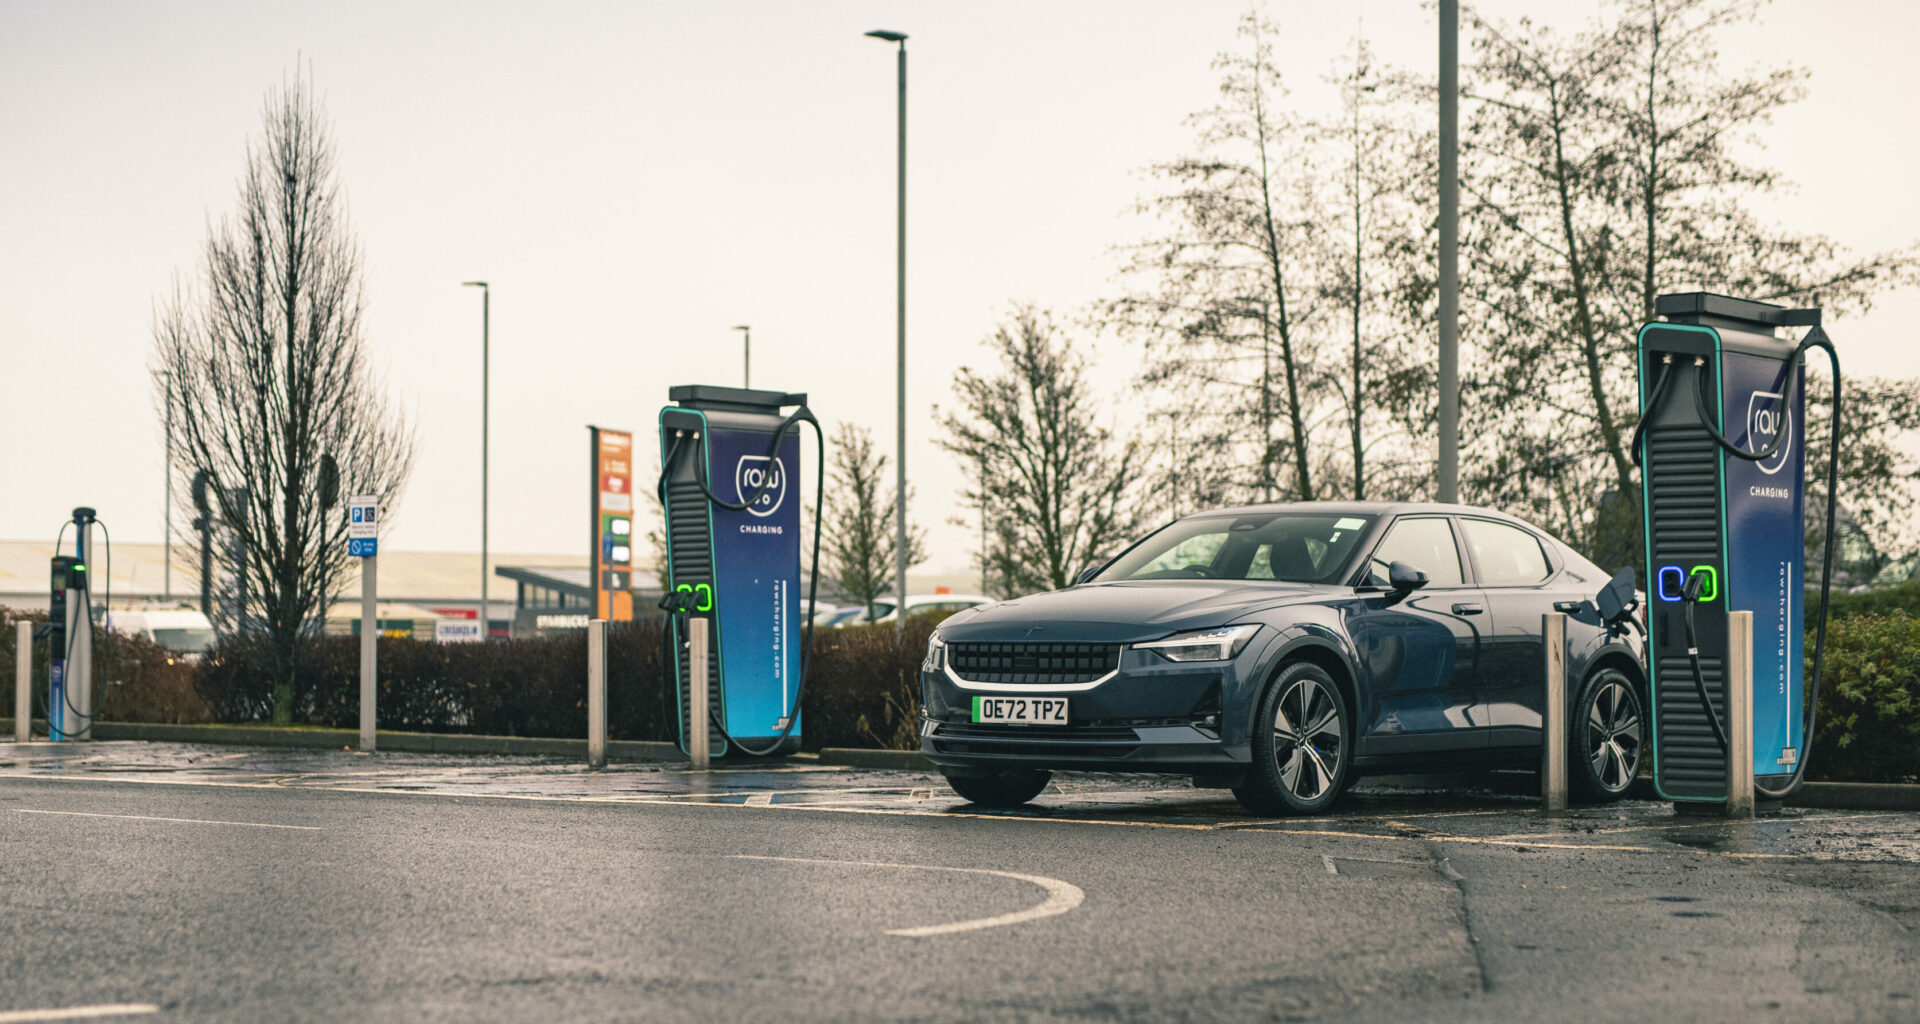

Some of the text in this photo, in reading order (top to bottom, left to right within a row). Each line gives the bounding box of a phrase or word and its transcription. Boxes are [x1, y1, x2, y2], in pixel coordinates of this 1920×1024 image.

[1750, 486, 1789, 499] CHARGING
[353, 509, 361, 521] P
[739, 524, 783, 535] CHARGING
[1778, 561, 1786, 695] rawcharging.com
[983, 699, 1065, 720] OE72 TPZ
